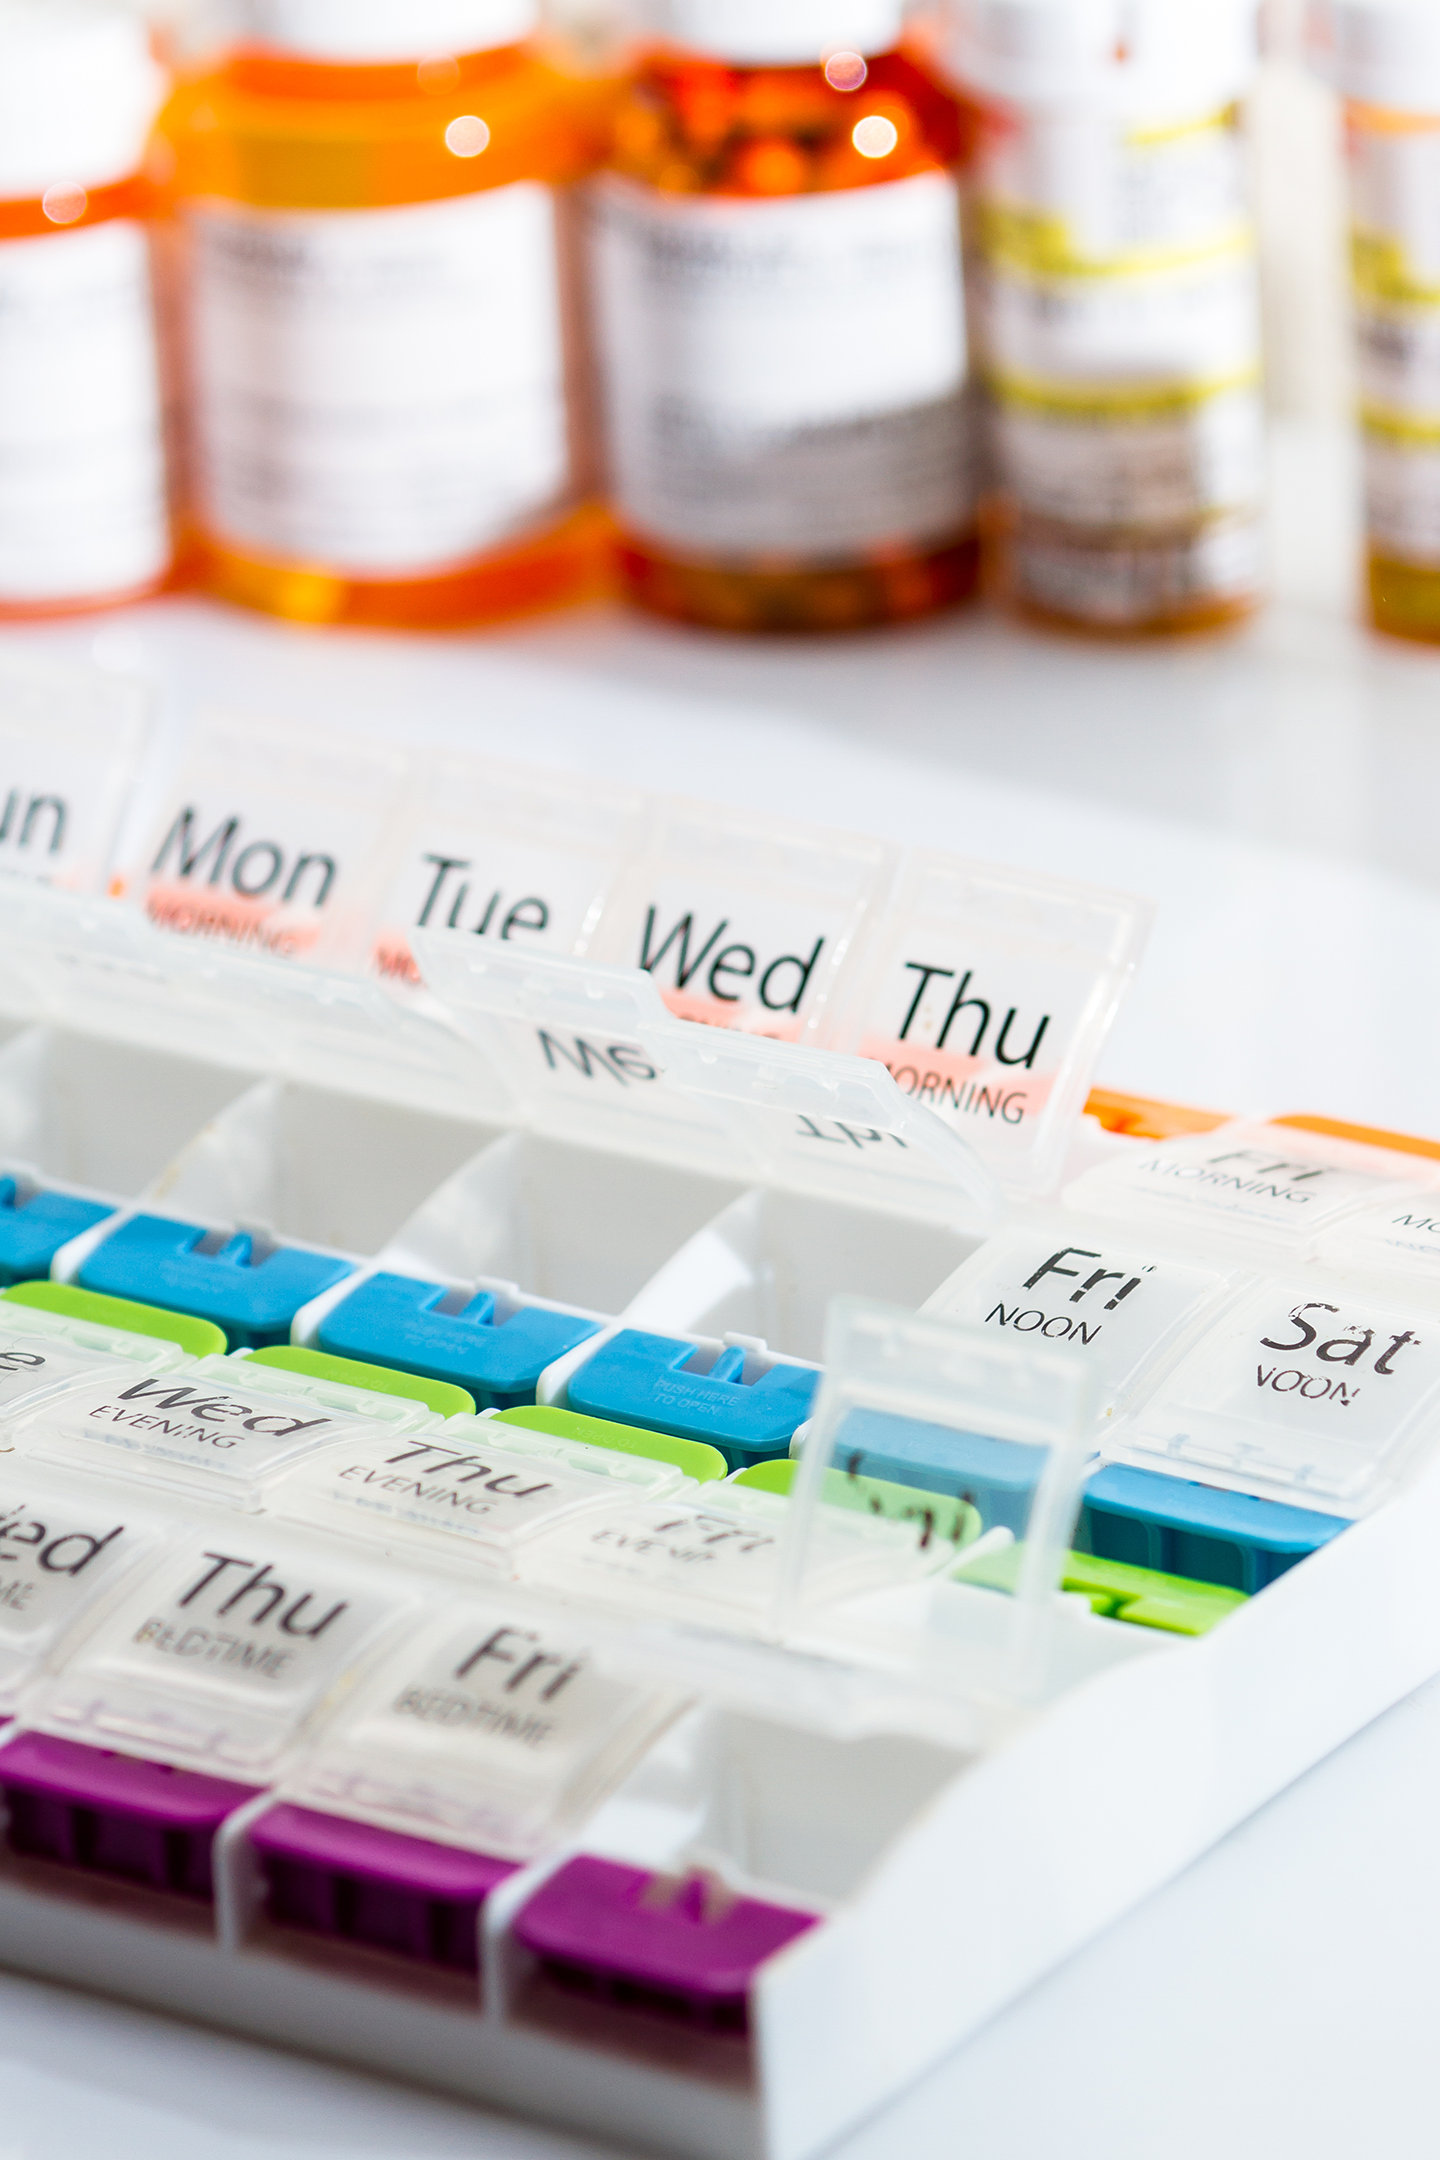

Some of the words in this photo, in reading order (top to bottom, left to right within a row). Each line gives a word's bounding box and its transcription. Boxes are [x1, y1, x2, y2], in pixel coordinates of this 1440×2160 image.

[150, 806, 337, 907] Mon
[417, 852, 551, 941] Tue
[639, 904, 825, 1014] Wed
[899, 961, 1051, 1069] Thu
[886, 1061, 1028, 1124] ORNING
[1139, 1158, 1318, 1204] MORNING
[1021, 1247, 1157, 1311] Fri
[985, 1302, 1103, 1346] NOON
[1259, 1302, 1423, 1376] Sat
[89, 1404, 245, 1449] EVENING
[117, 1378, 333, 1437] Wed
[338, 1464, 500, 1515] EVENING
[384, 1440, 554, 1498] Thu
[178, 1551, 349, 1641] Thu
[454, 1625, 588, 1703] Fri
